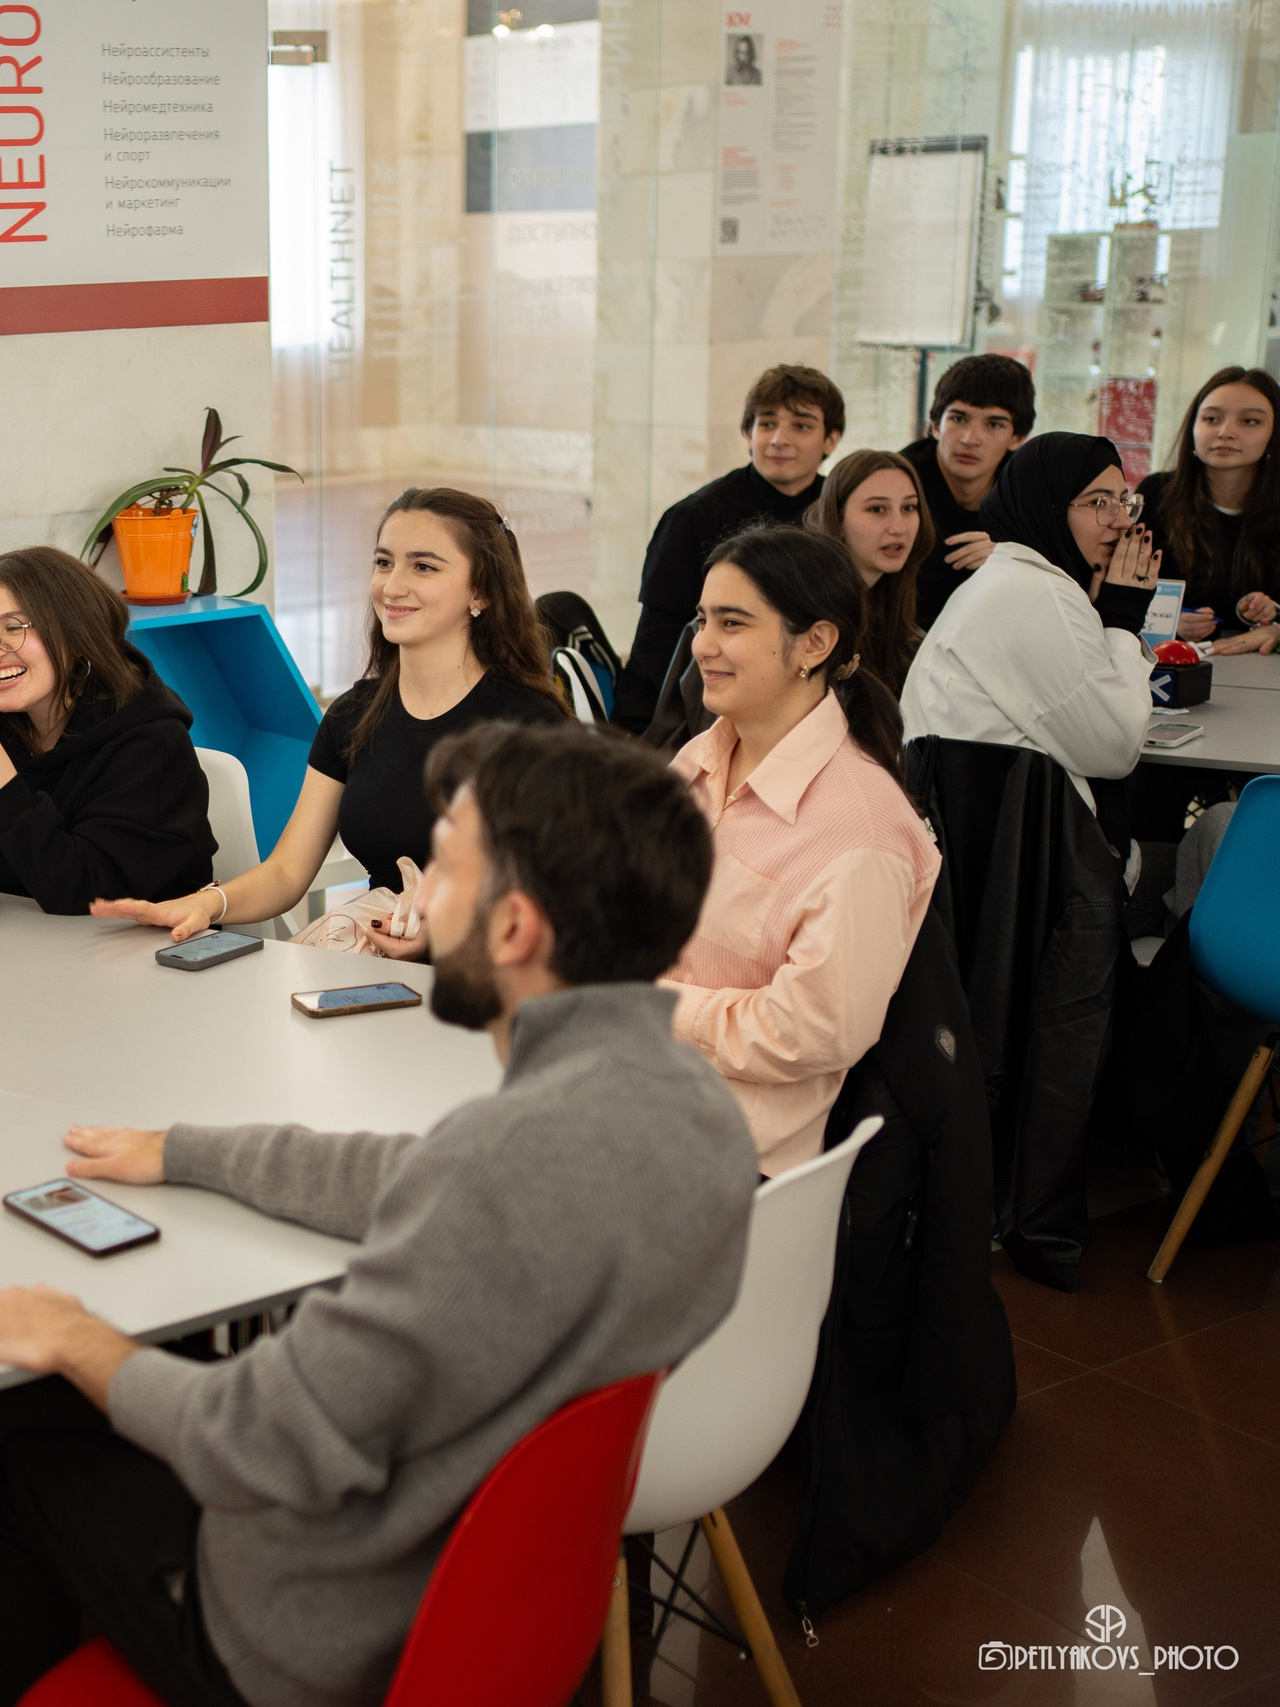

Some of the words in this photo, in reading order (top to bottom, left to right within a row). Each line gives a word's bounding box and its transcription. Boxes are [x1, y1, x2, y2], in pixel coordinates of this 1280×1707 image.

[101, 43, 210, 59] Нейроассистенты
[102, 71, 221, 87] Нейрообразование
[102, 99, 214, 115] Нейромедтехника
[103, 127, 220, 143] Нейроразвлечения
[104, 152, 112, 161] и
[116, 149, 151, 163] спорт
[104, 175, 232, 191] Нейрокоммуникации
[105, 200, 113, 209] и
[117, 197, 181, 210] маркетинг
[106, 223, 184, 238] Нейрофарма
